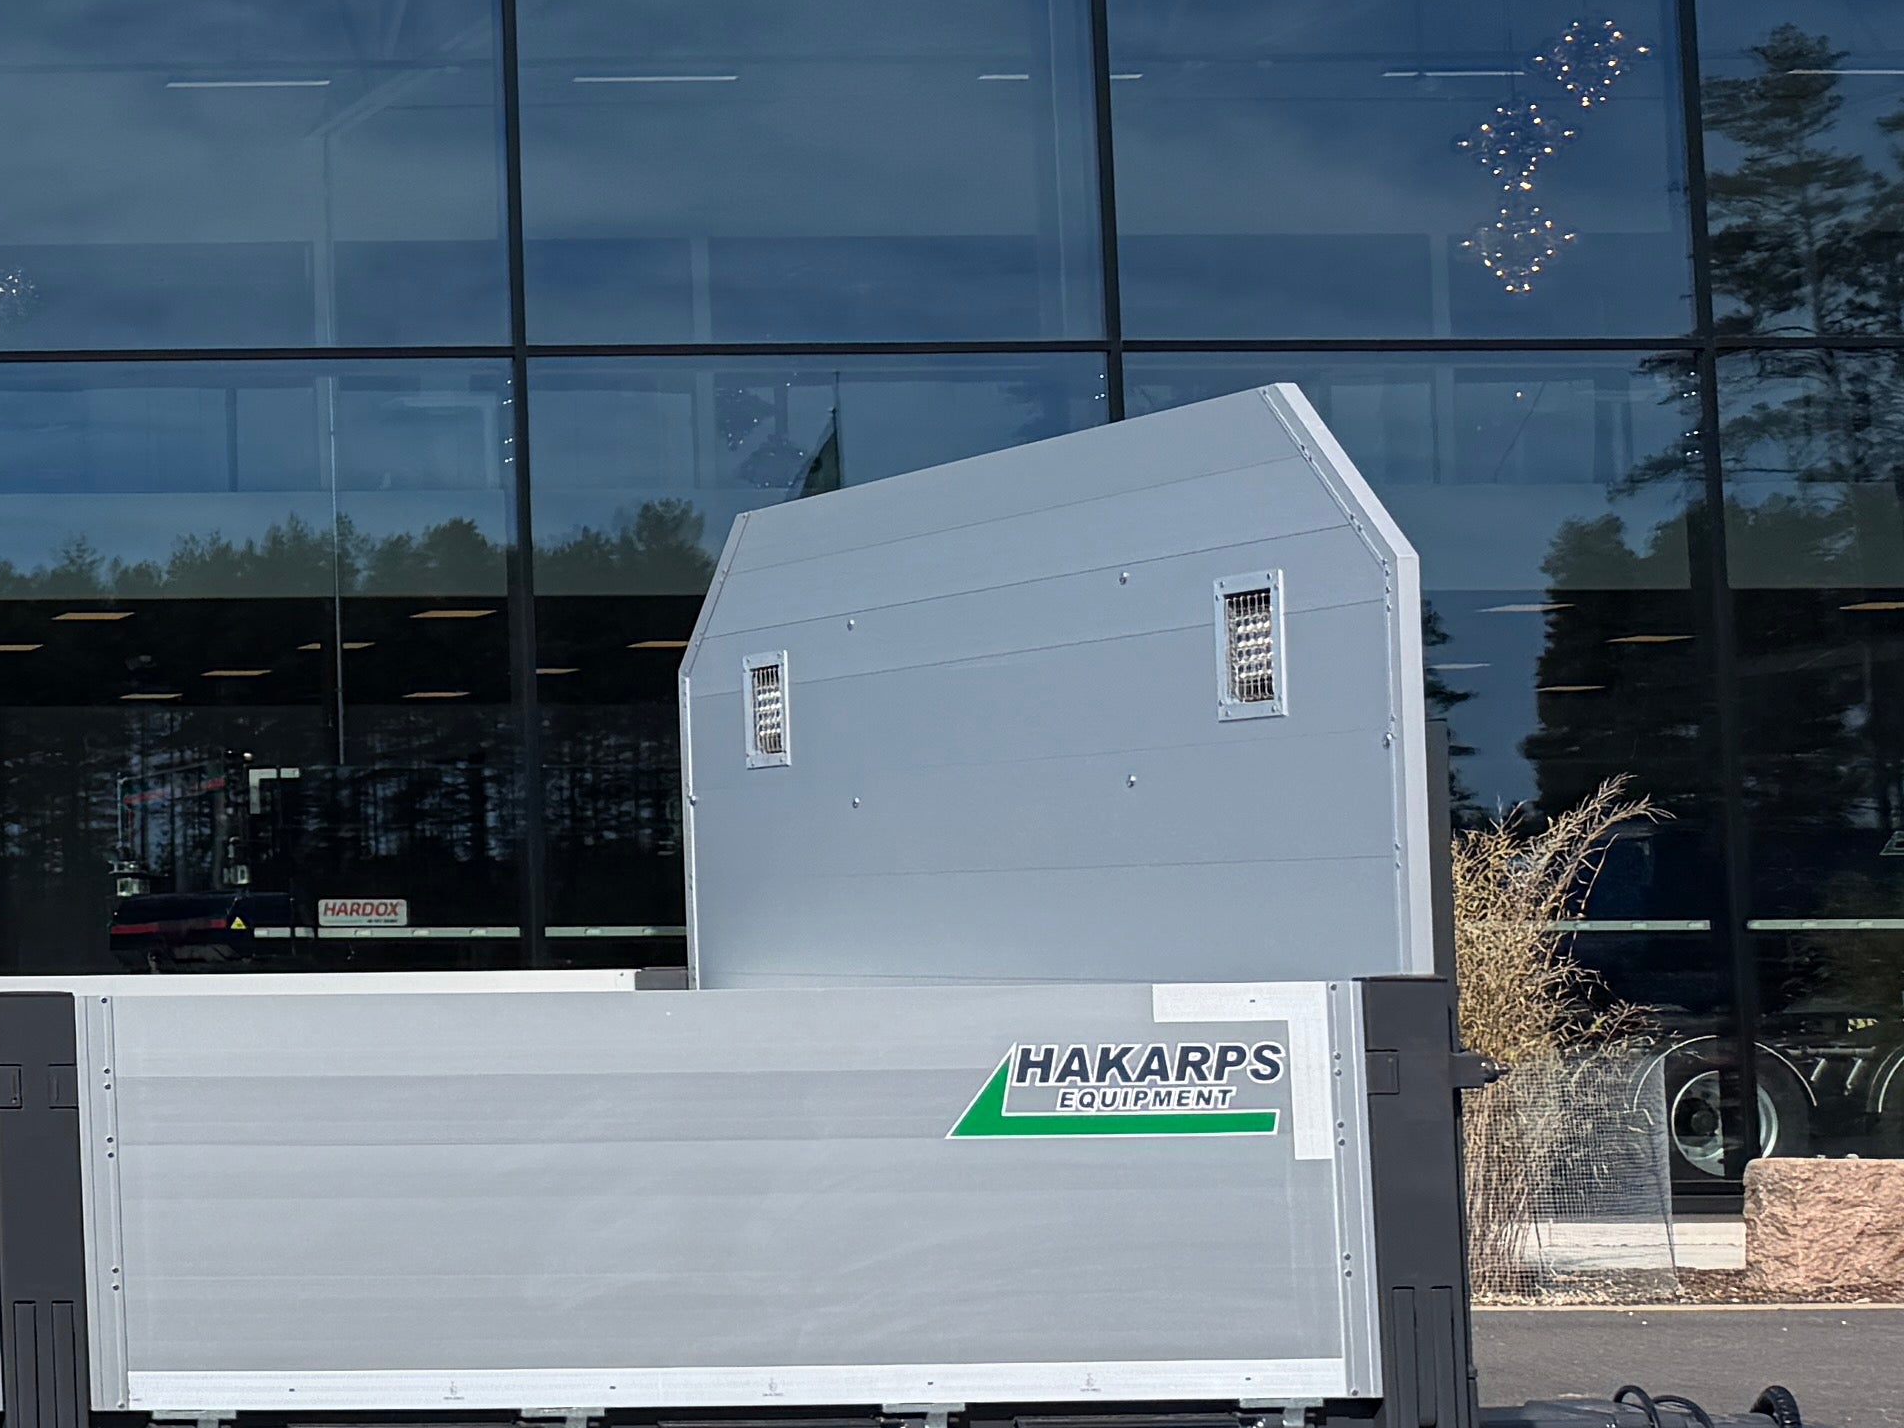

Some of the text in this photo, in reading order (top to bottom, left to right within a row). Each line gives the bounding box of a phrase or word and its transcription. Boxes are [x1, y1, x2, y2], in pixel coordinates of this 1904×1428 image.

[323, 902, 399, 917] HARDOX
[1013, 1043, 1284, 1085] HAKARPS
[1058, 1088, 1234, 1110] EQUIPMENT
